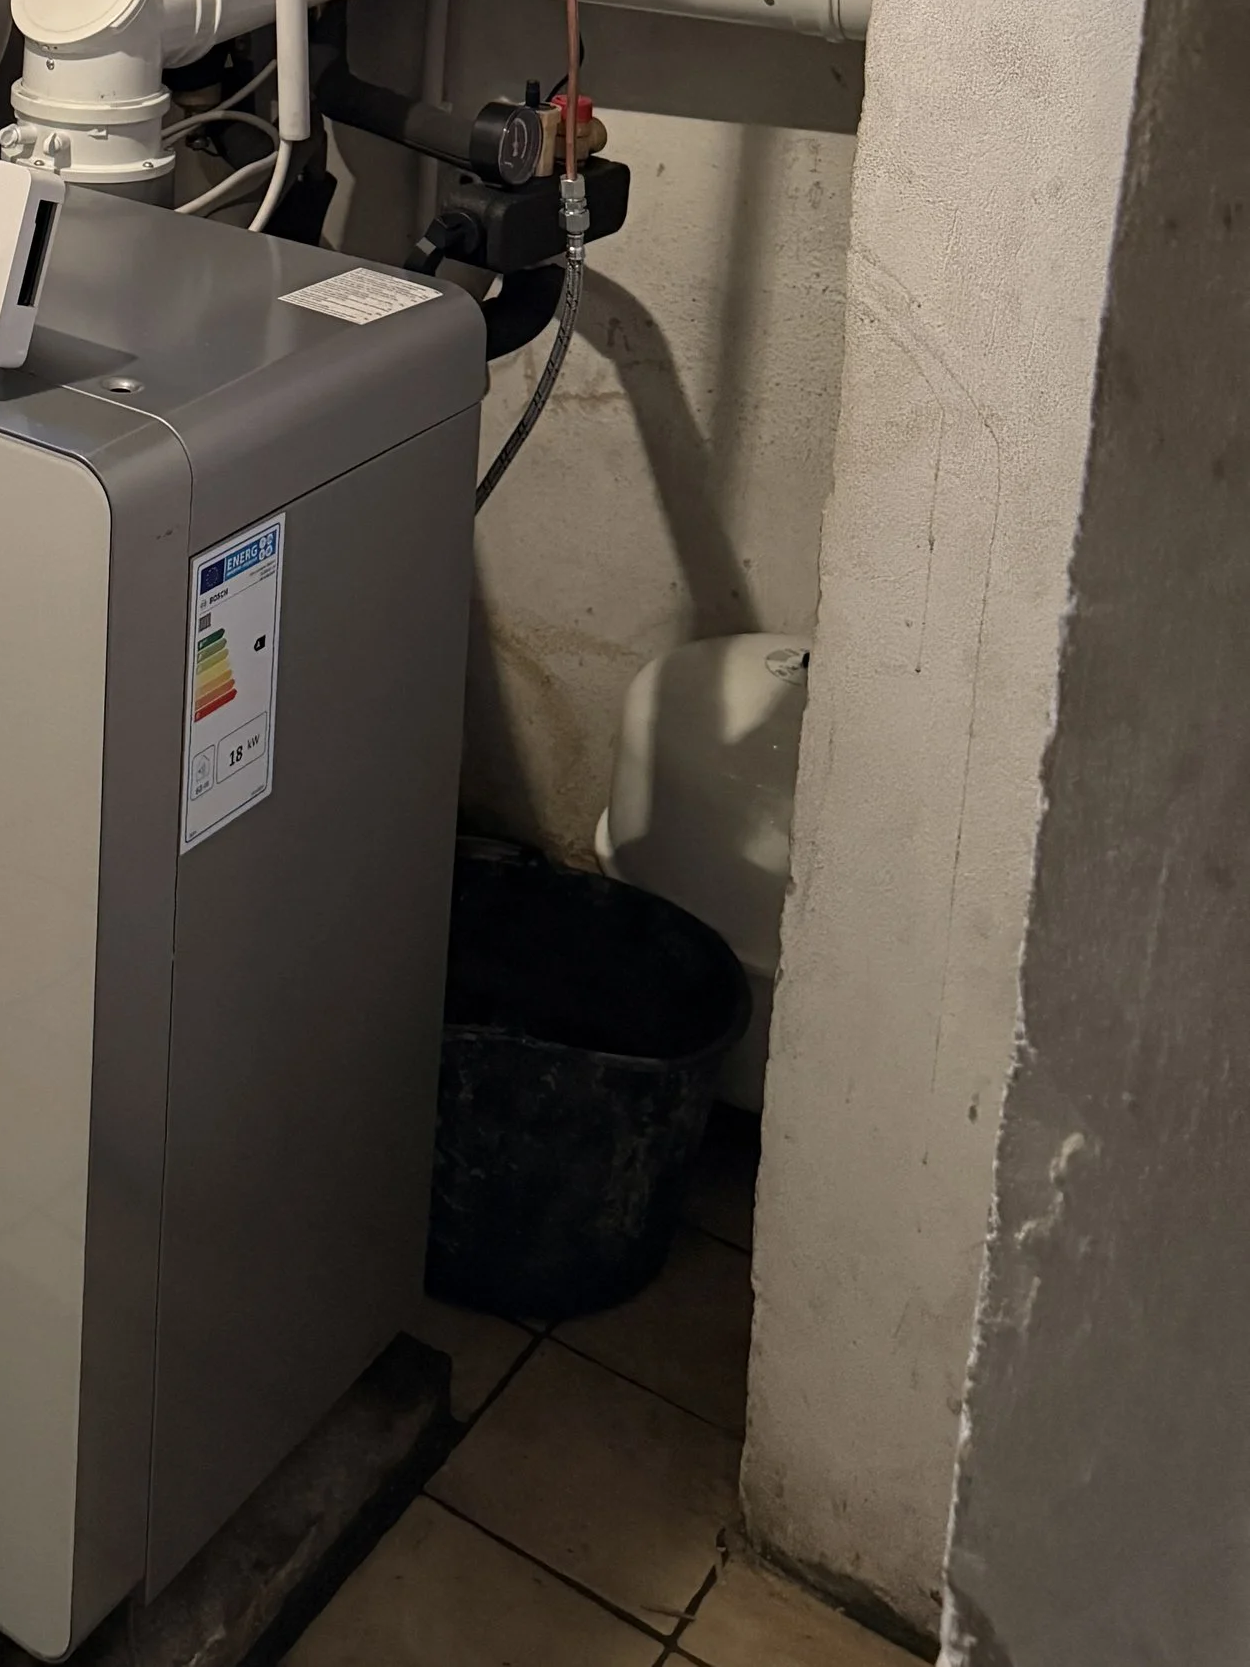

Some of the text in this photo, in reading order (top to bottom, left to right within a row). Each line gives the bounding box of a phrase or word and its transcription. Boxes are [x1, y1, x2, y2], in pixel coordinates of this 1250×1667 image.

[227, 545, 258, 570] ENERG
[209, 587, 229, 605] BOSCH
[229, 733, 260, 767] 18 kW
